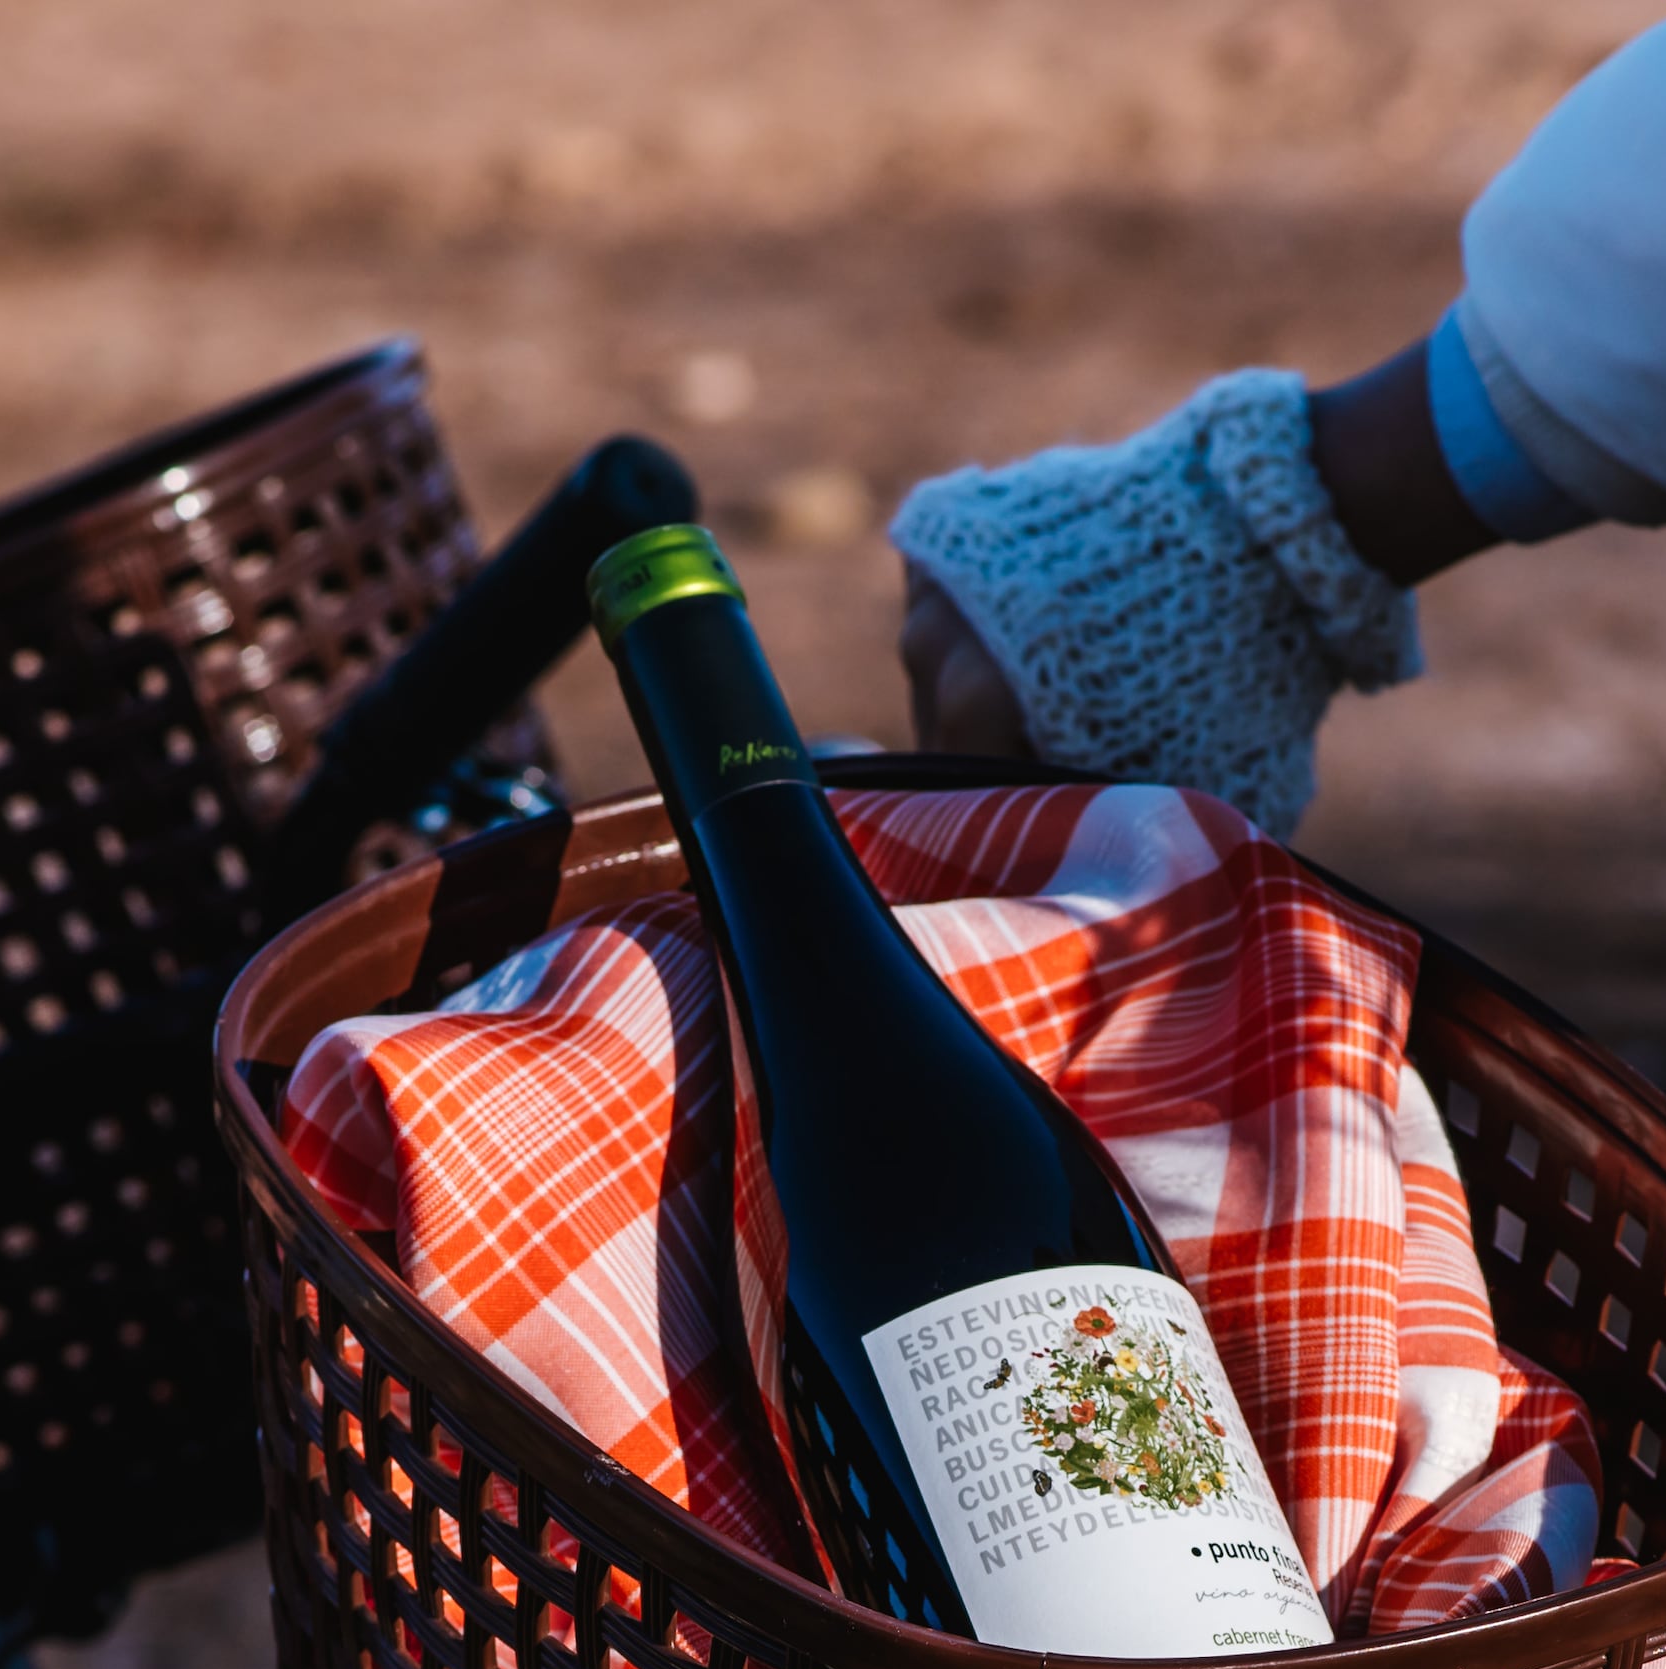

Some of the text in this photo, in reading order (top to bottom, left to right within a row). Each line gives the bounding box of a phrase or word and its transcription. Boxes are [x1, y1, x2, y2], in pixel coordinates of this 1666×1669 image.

[1207, 1540, 1270, 1563] punto
[1195, 1587, 1255, 1603] vino
[1213, 1628, 1285, 1647] cabernet
